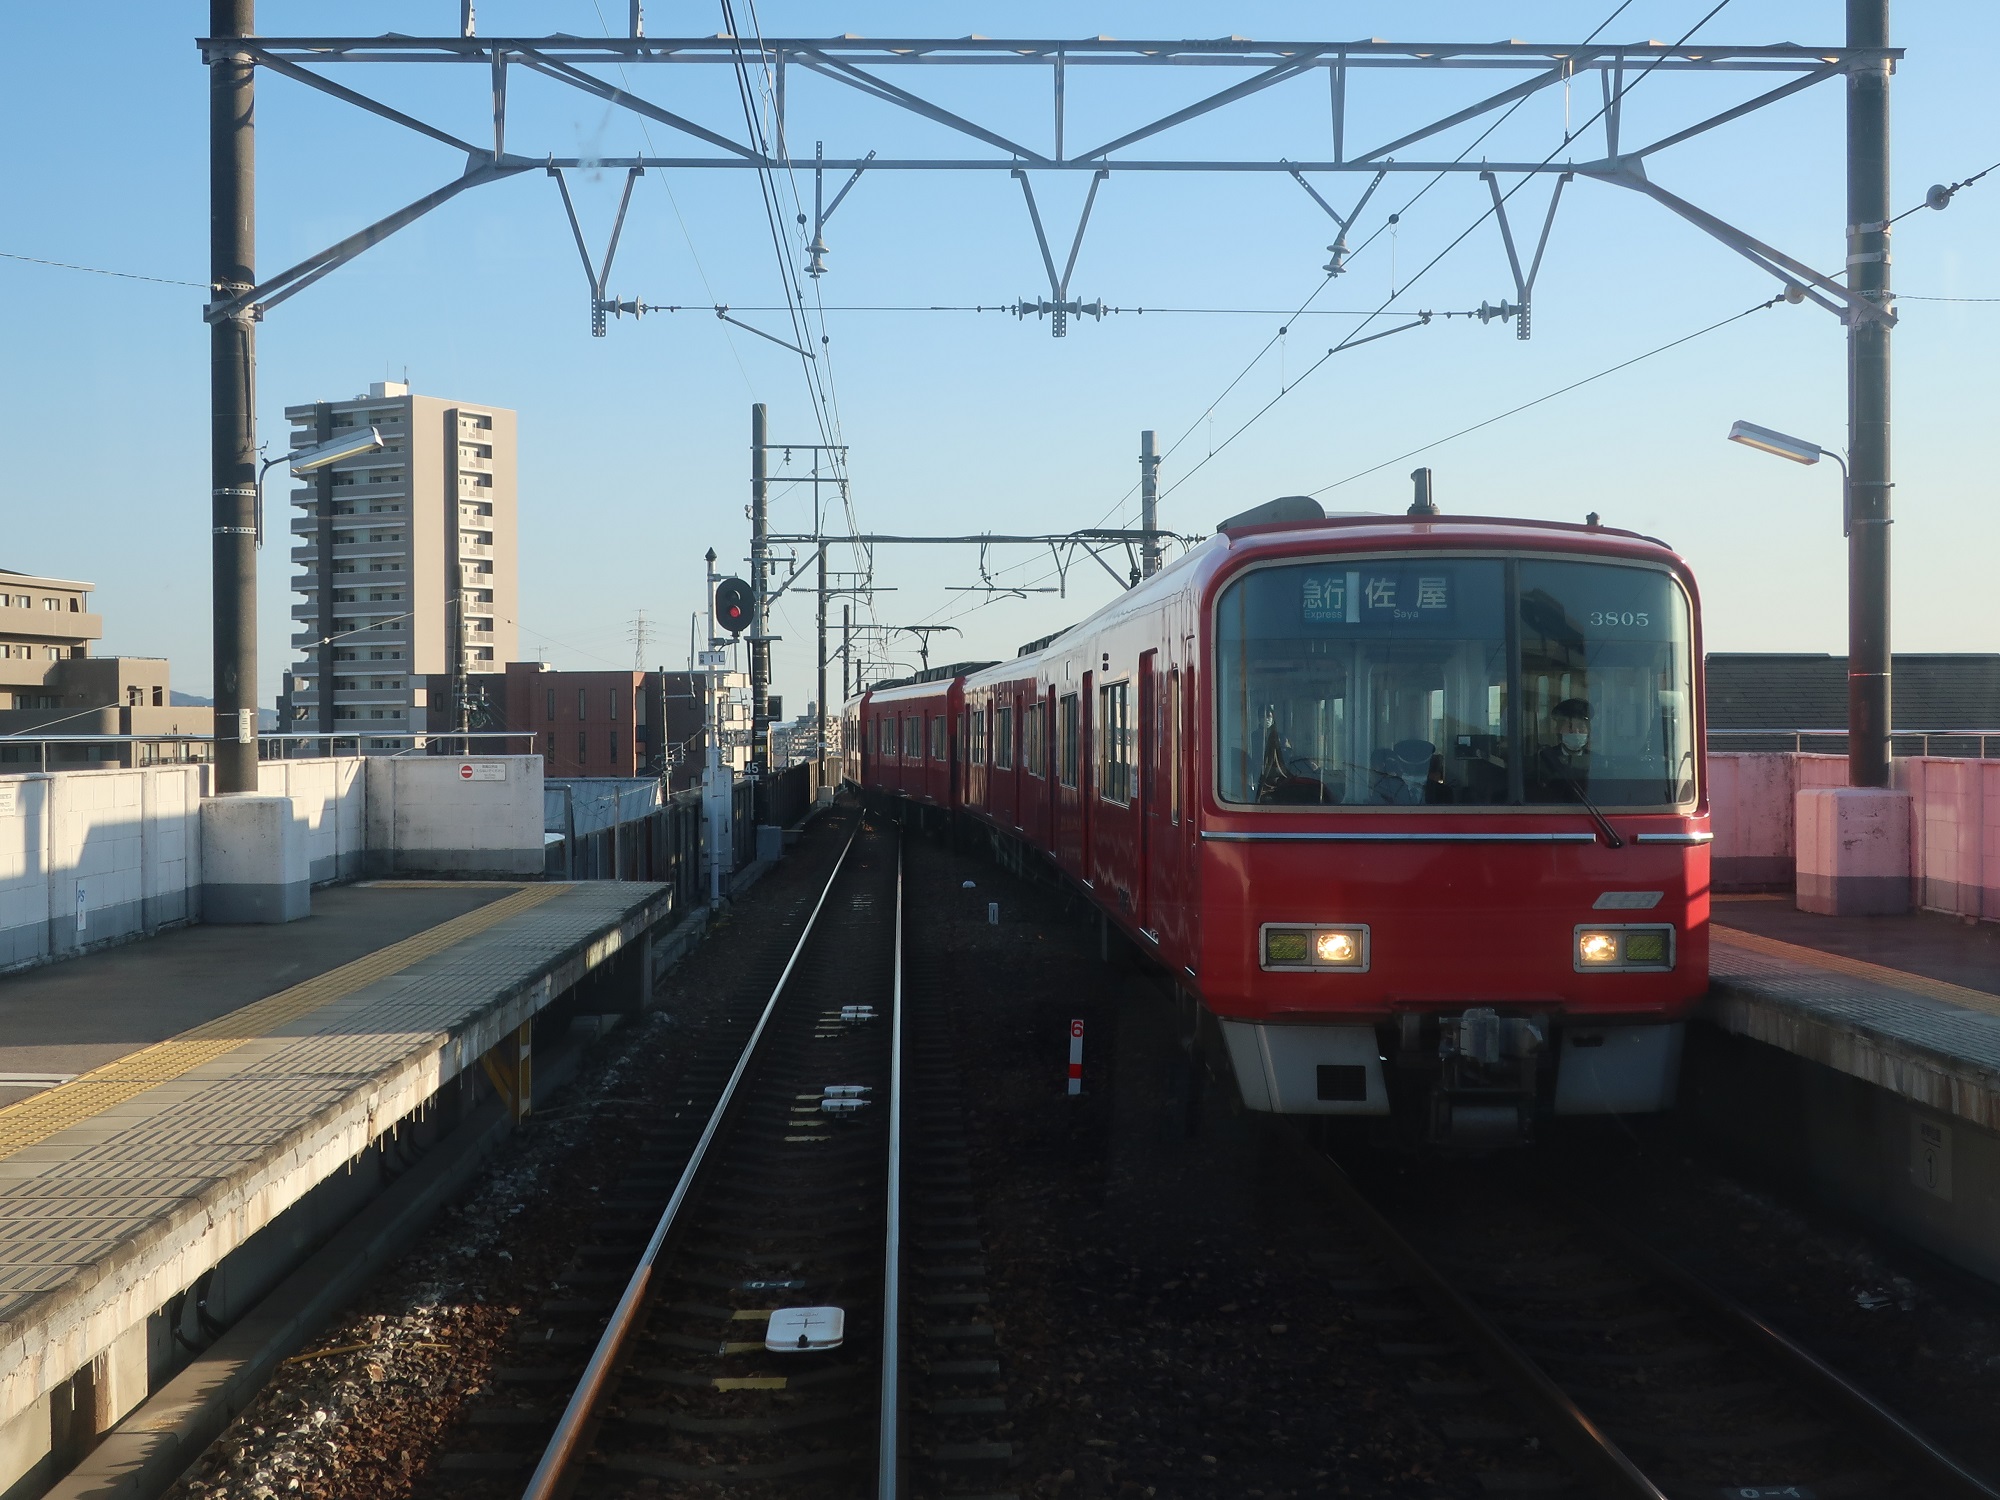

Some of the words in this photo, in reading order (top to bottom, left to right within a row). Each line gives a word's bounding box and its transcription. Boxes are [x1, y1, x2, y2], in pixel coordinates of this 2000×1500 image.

[1302, 577, 1345, 609] 急行
[1365, 577, 1448, 609] 佐屋
[1304, 610, 1342, 620] Express
[1393, 609, 1419, 620] Saya
[1590, 611, 1650, 627] 3805
[745, 762, 759, 774] 45
[1071, 1020, 1084, 1038] 6
